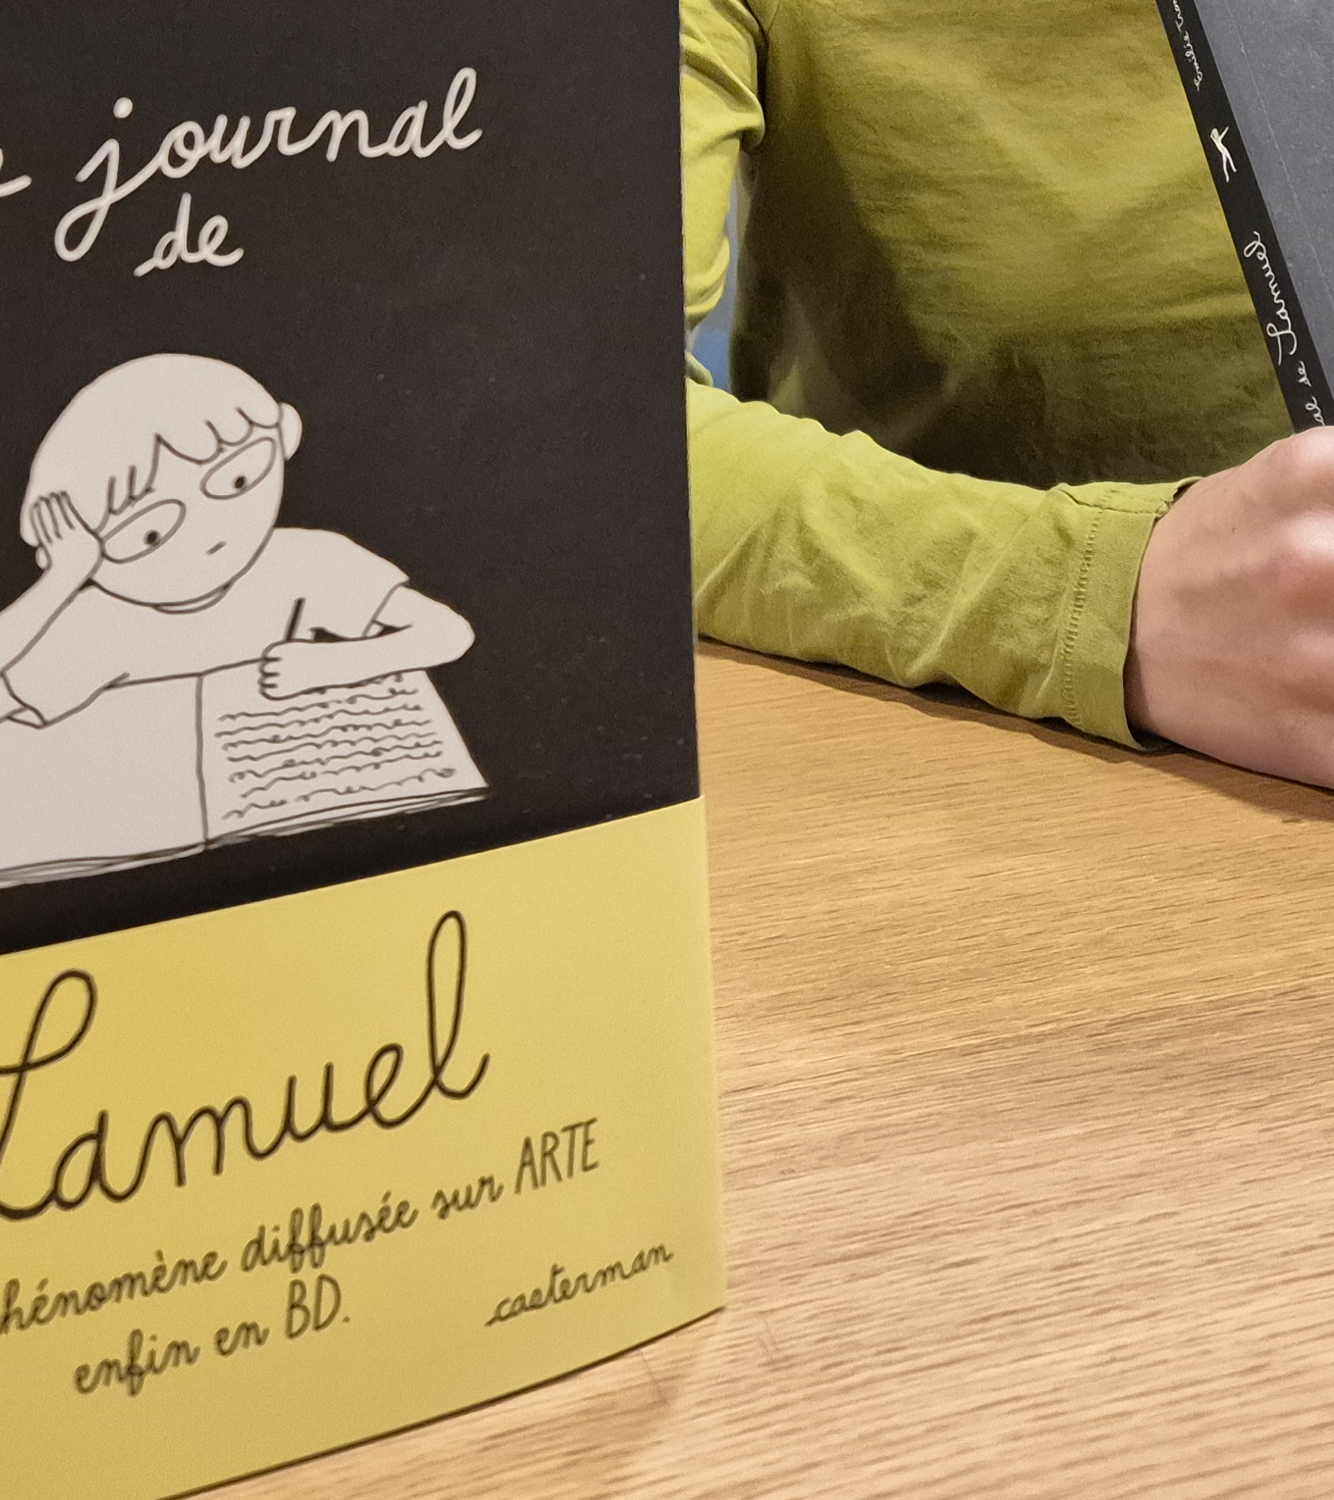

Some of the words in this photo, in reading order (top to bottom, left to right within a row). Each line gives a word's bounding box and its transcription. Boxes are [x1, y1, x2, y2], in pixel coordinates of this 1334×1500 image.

[1182, 31, 1204, 92] Emilie
[53, 66, 484, 262] journal
[133, 192, 245, 278] de
[240, 1190, 421, 1276] diffusée
[430, 1173, 505, 1221] sur
[514, 1115, 600, 1198] ARTE
[484, 1236, 674, 1326] casterman
[72, 1327, 200, 1398] enfin
[213, 1315, 270, 1357] en
[284, 1274, 352, 1340] BD.
